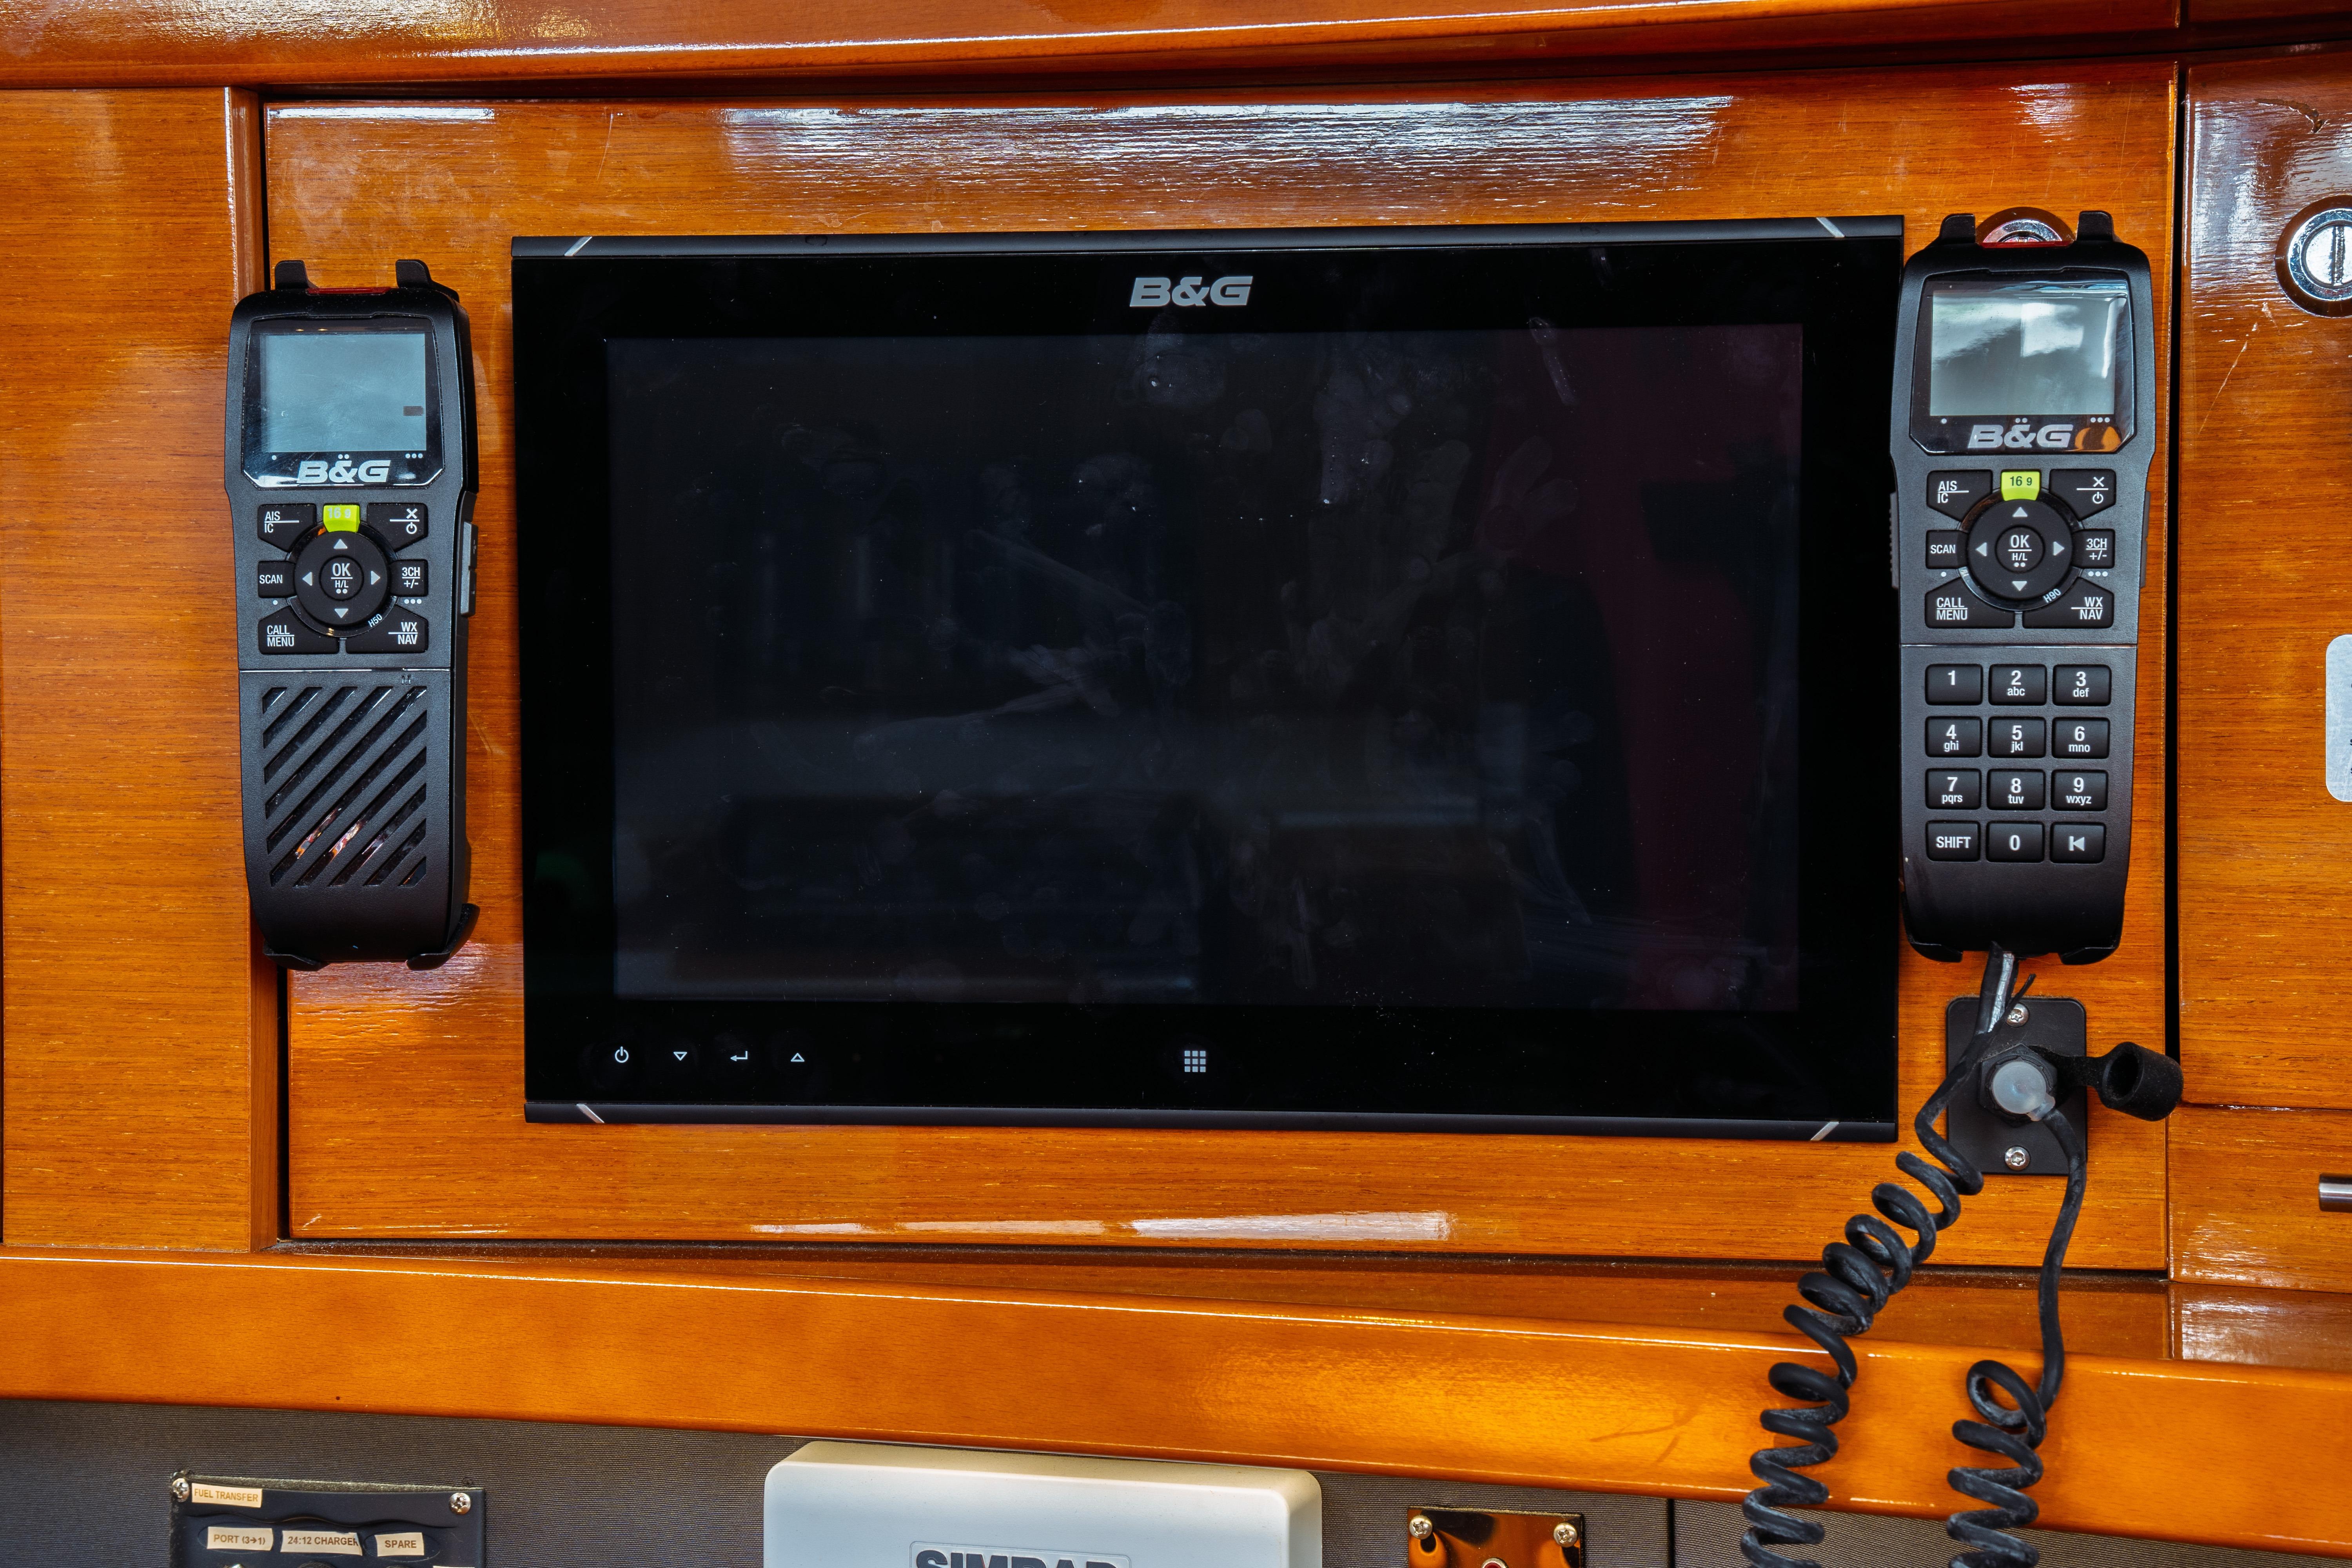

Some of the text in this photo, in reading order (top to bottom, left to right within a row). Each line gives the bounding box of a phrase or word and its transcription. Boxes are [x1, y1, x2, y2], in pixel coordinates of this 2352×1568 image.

[1129, 276, 1253, 307] B&G
[1968, 424, 2073, 448] B&G
[297, 460, 391, 483] B&G
[1938, 481, 1957, 491] AIS
[2010, 476, 2032, 486] 16 9
[1938, 492, 1948, 503] IC
[265, 511, 280, 521] AIS
[327, 508, 351, 518] 16 9
[264, 523, 274, 533] IC
[2010, 535, 2030, 548] OK
[2087, 538, 2107, 548] 3CH
[1930, 544, 1956, 554] SCAN
[2012, 552, 2028, 561] H/L
[332, 563, 351, 576] OK
[402, 566, 420, 577] 3CH
[259, 574, 283, 584] SCAN
[335, 580, 349, 588] H/L
[2043, 588, 2061, 603] H90
[1936, 597, 1965, 608] CALL
[2084, 597, 2103, 607] WX
[1936, 610, 1967, 620] MENU
[2080, 609, 2103, 620] NAV
[368, 614, 383, 628] H50
[267, 625, 288, 635] CALL
[401, 622, 417, 632] WX
[267, 637, 294, 647] MENU
[397, 634, 418, 644] NAV
[1948, 670, 1955, 685] 1
[2011, 670, 2021, 685] 2
[2076, 671, 2086, 686] 3
[2007, 686, 2025, 696] abc
[2073, 687, 2089, 697] def
[1946, 724, 1957, 739] 4
[2012, 725, 2022, 740] 5
[2074, 726, 2085, 741] 6
[1944, 740, 1959, 752] ghi
[2011, 741, 2023, 753] jkl
[2069, 744, 2090, 752] mno
[1947, 777, 1958, 791] 7
[2011, 778, 2021, 793] 8
[2074, 777, 2084, 793] 9
[1942, 795, 1963, 804] pqrs
[2007, 794, 2024, 804] tuv
[2066, 795, 2092, 806] wxyz
[1936, 836, 1971, 848] SHIFT
[2010, 835, 2020, 851] 0
[194, 1488, 258, 1502] FUEL TRANSFER
[214, 1534, 240, 1543] PORT
[287, 1536, 312, 1544] 24:12
[385, 1540, 417, 1548] SPARE
